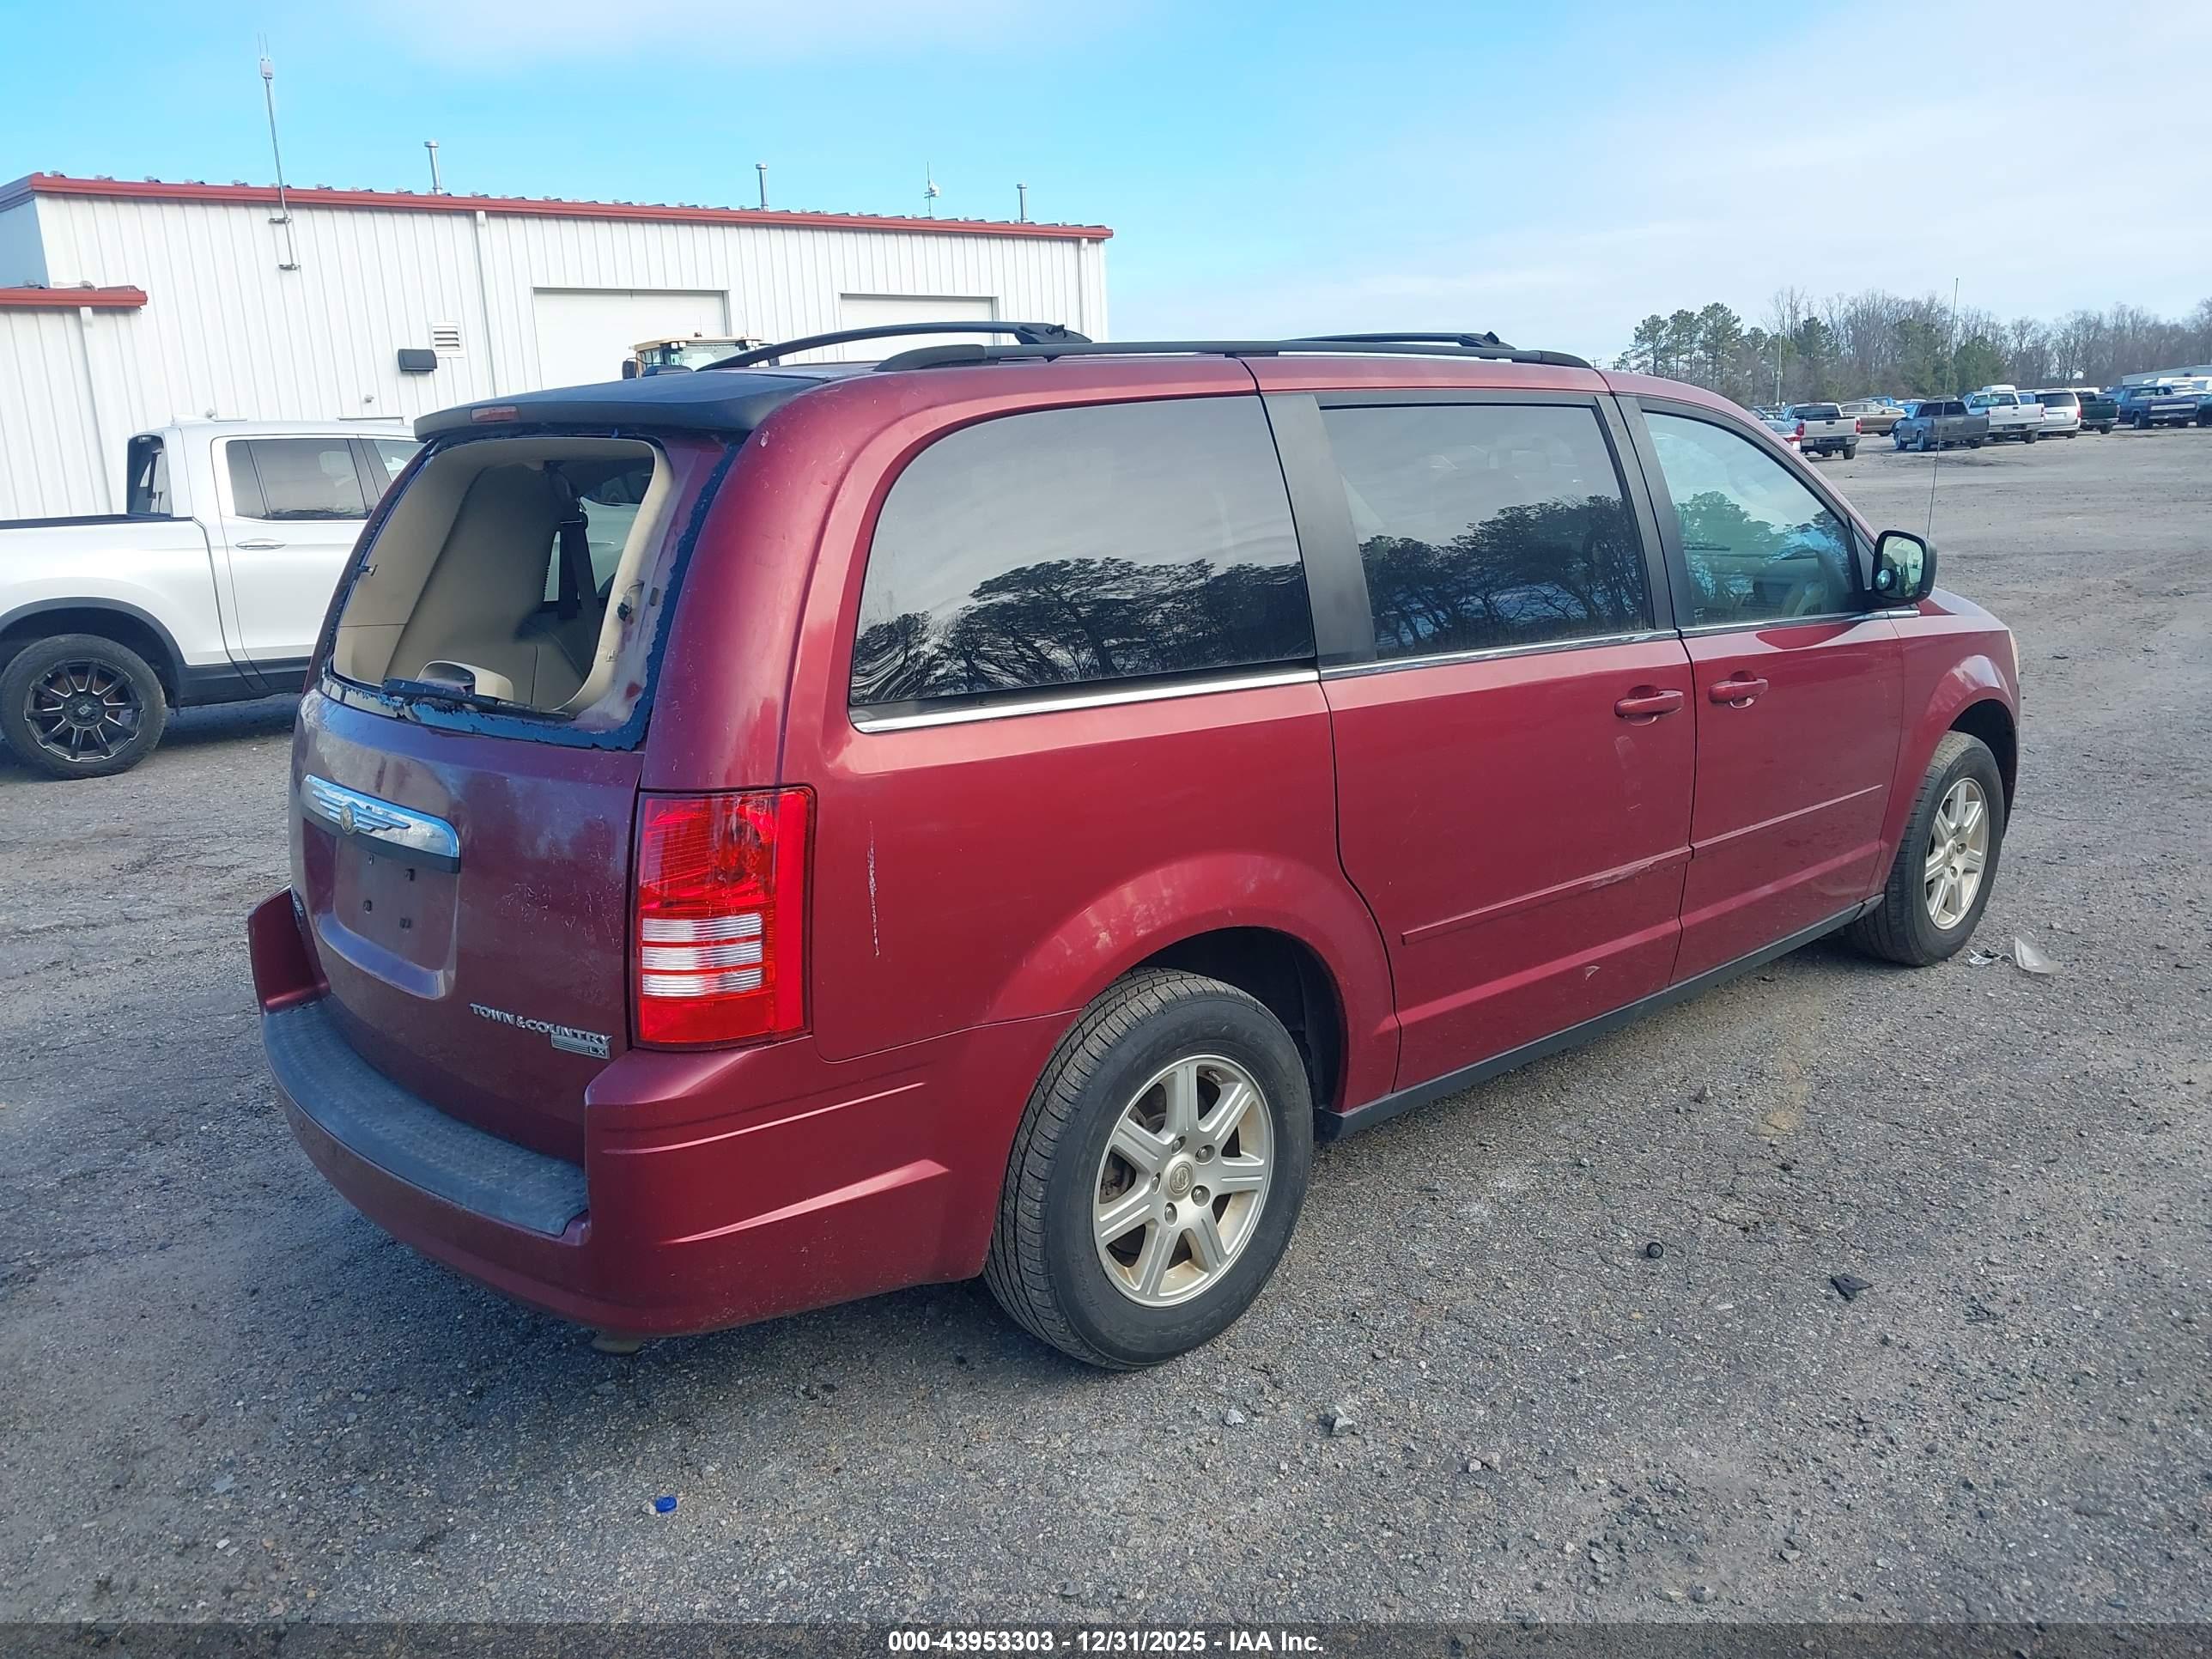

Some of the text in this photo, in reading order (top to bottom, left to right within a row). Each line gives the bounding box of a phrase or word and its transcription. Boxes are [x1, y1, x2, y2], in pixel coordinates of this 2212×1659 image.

[470, 1003, 515, 1024] TOWN
[526, 1019, 612, 1046] COUNTRY
[589, 1046, 606, 1056] LX
